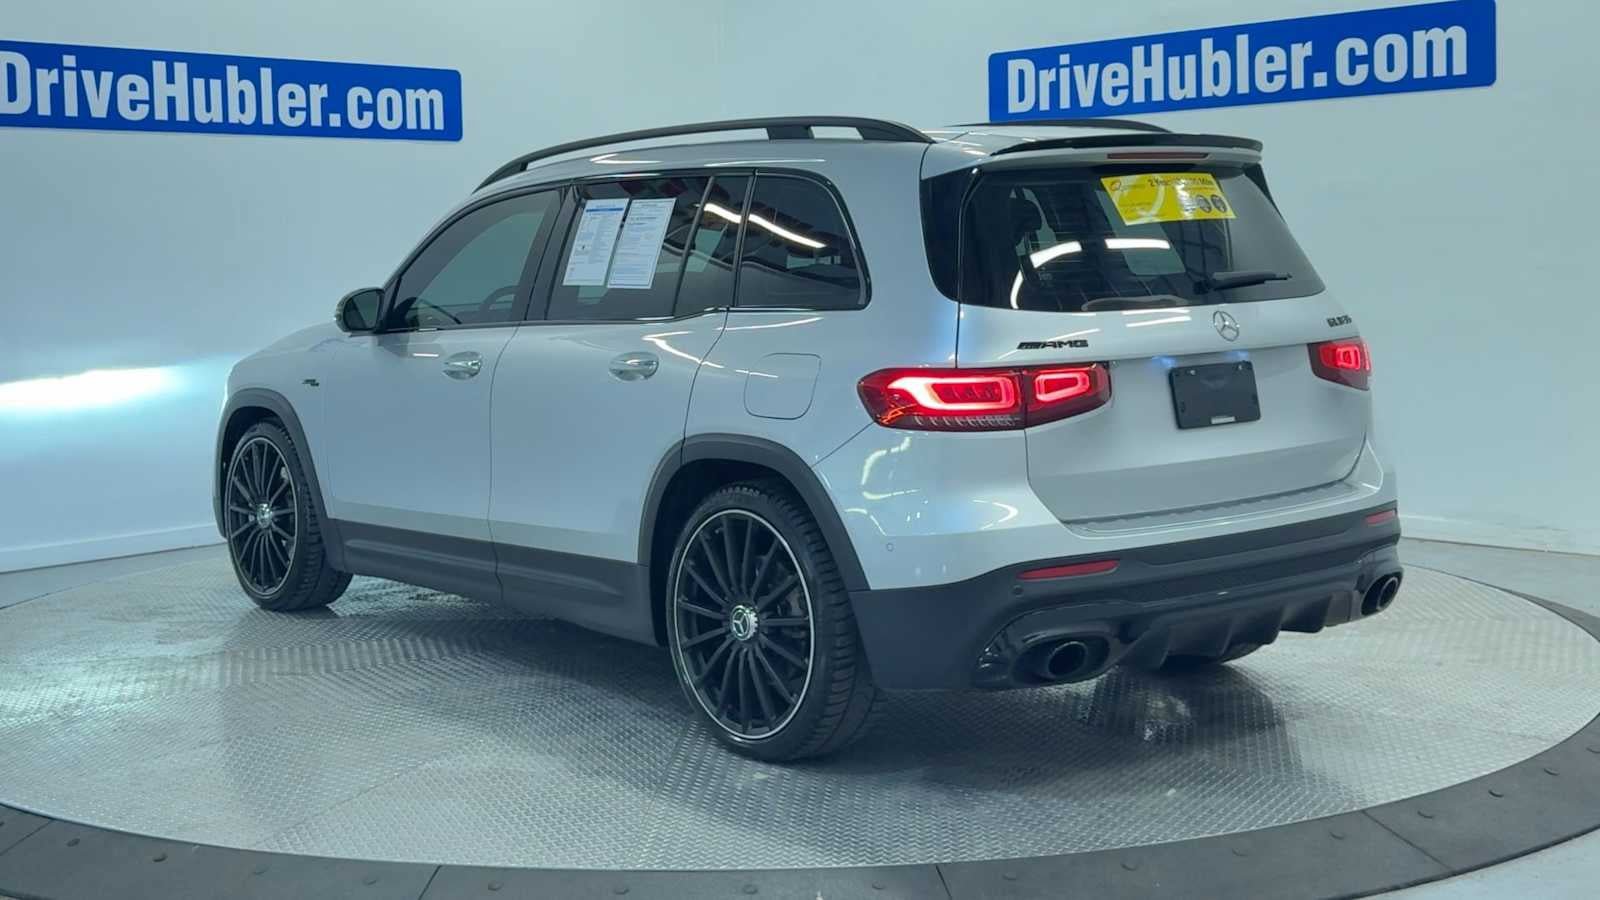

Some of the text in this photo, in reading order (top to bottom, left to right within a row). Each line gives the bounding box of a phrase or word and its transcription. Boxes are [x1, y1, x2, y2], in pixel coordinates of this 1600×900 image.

[0, 50, 445, 131] DriveHubler.com
[1007, 24, 1468, 113] DriveHubler.com
[1041, 339, 1089, 350] AMG
